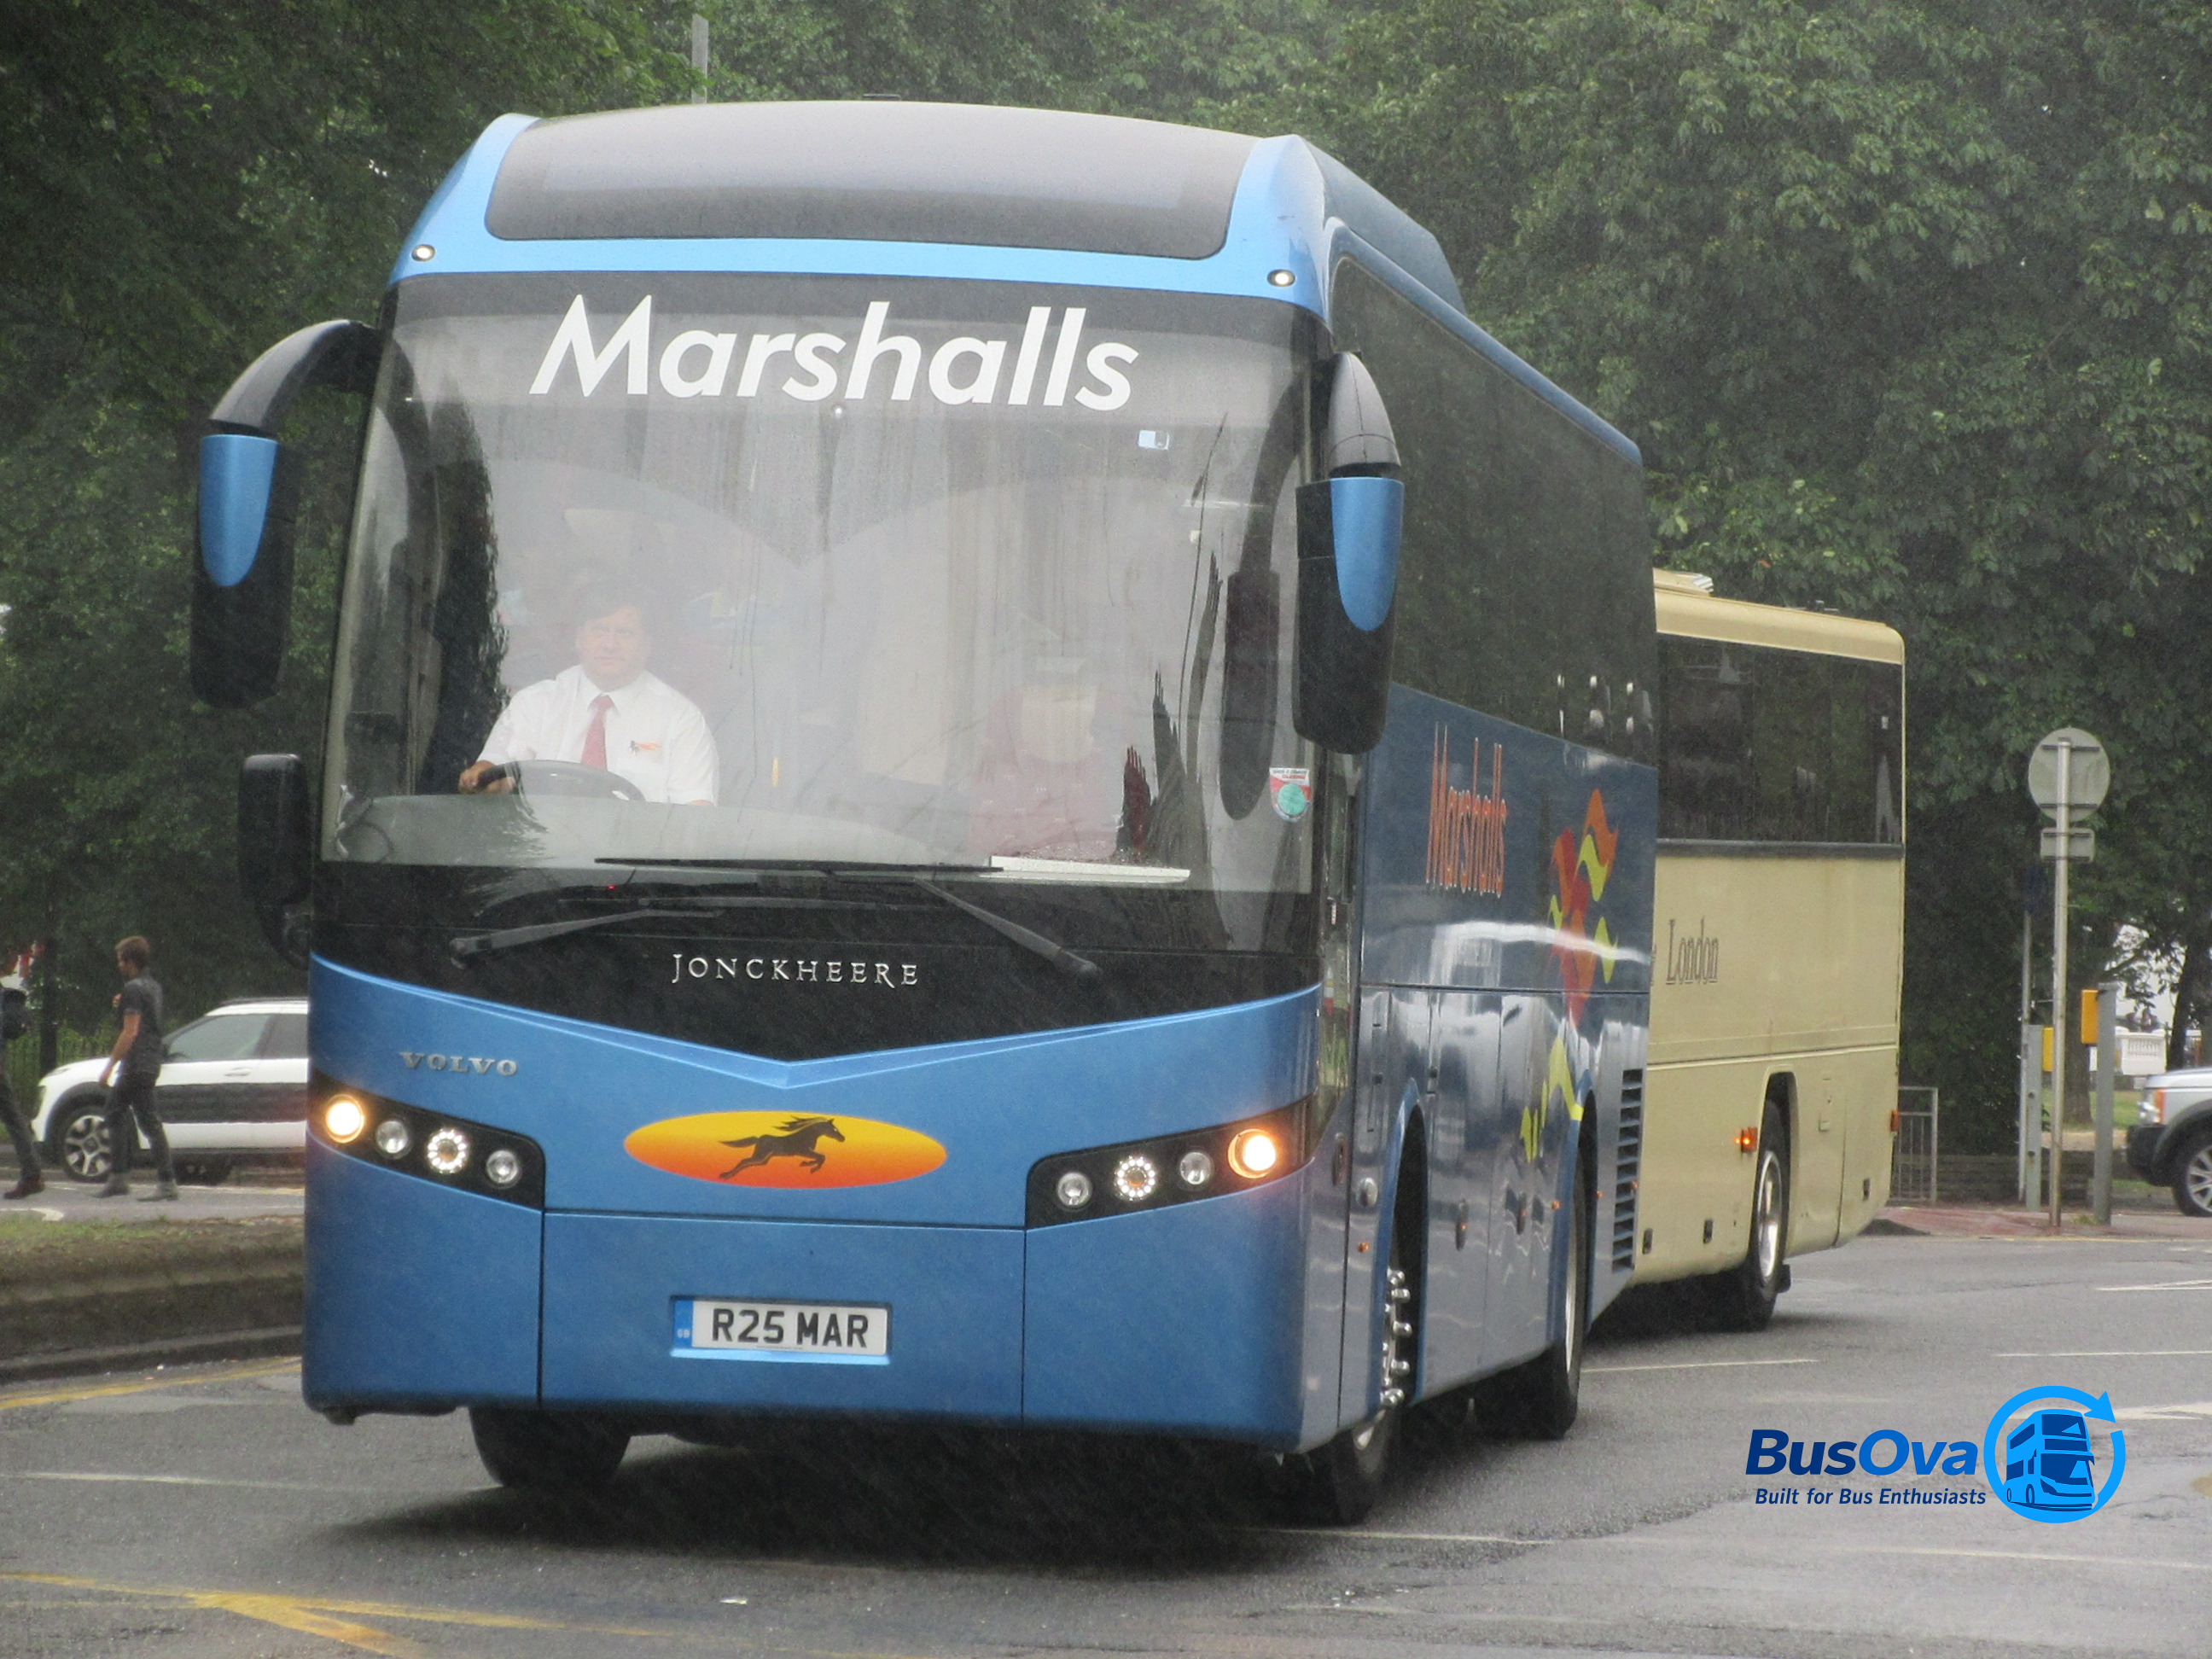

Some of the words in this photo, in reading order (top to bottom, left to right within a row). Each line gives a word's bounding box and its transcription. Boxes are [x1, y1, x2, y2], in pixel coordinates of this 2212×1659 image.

[529, 294, 1139, 410] Marshalls
[1425, 721, 1508, 899] Marshalls
[672, 953, 918, 988] JONCKHEERE
[1666, 916, 1719, 985] London
[399, 1051, 518, 1076] VOLVO
[712, 1307, 785, 1344] R25
[796, 1312, 869, 1348] MAR
